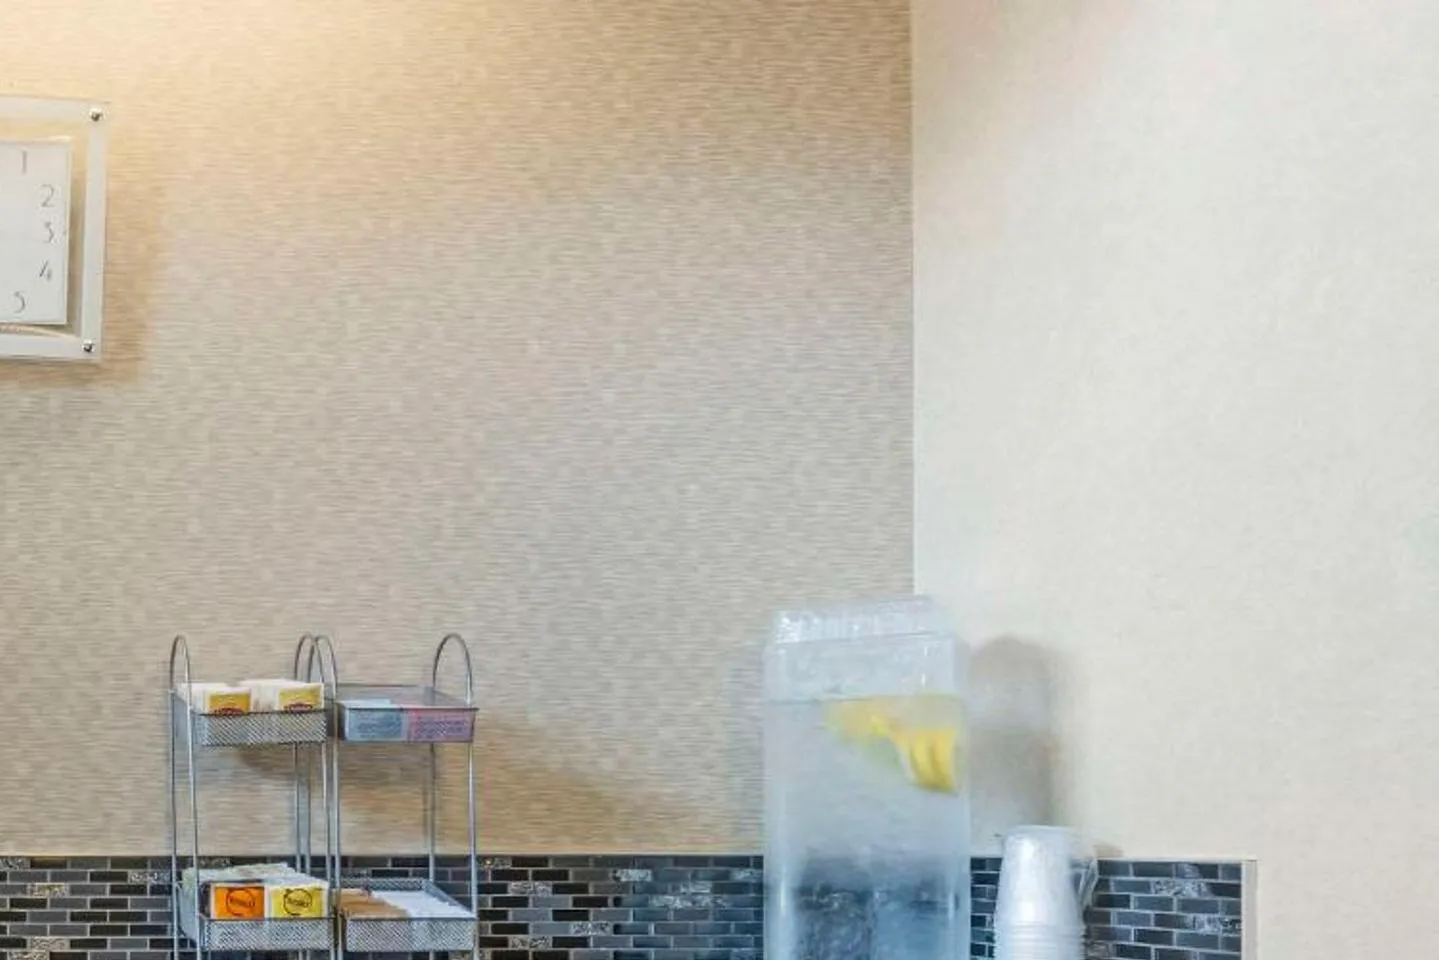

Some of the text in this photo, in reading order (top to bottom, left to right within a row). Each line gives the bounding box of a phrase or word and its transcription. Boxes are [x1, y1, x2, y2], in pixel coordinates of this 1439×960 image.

[21, 151, 28, 175] 1
[40, 183, 56, 208] 2
[43, 220, 56, 244] 3
[38, 259, 55, 282] 4
[12, 291, 28, 314] 5
